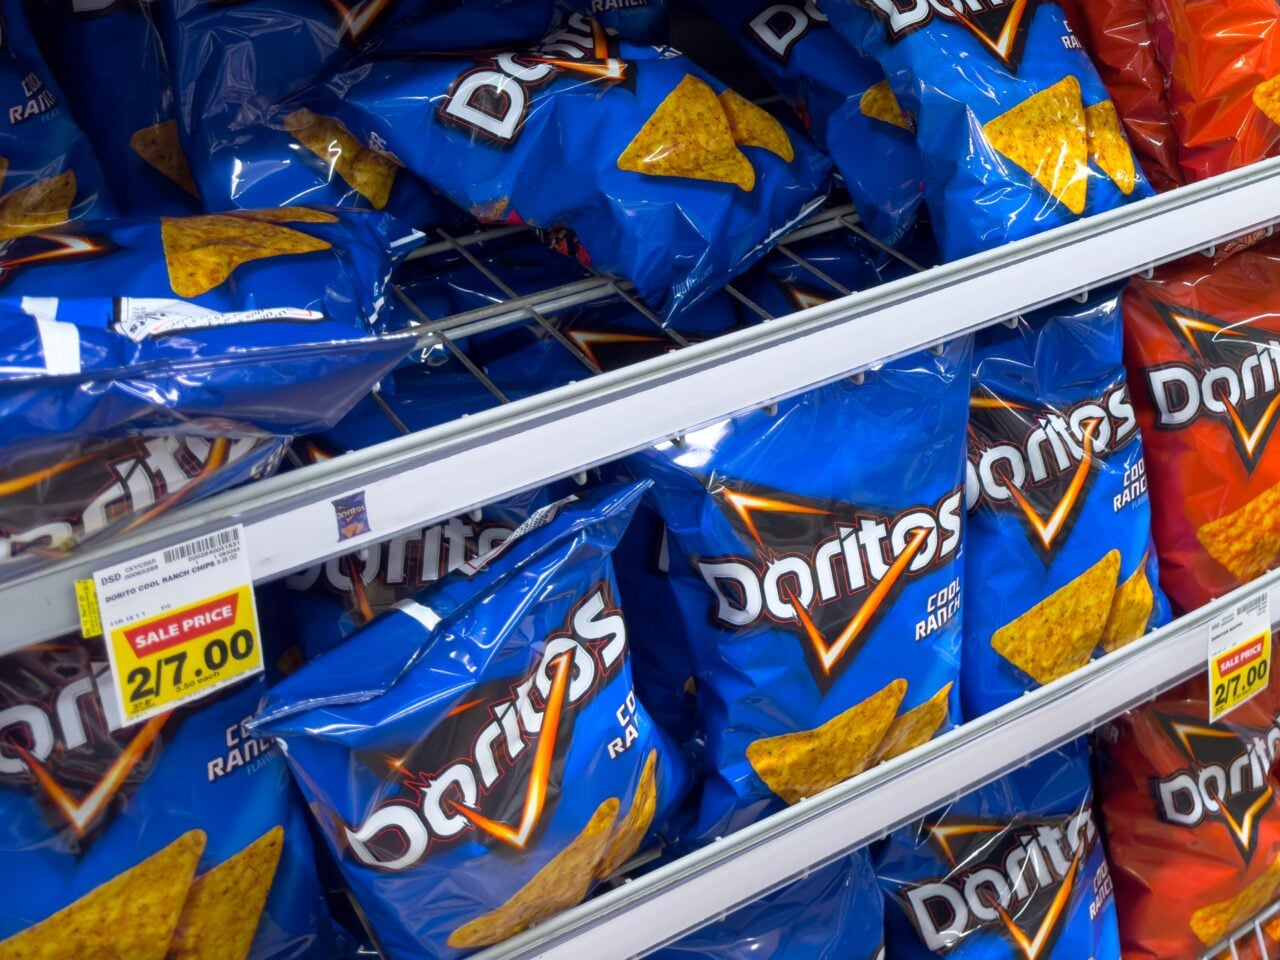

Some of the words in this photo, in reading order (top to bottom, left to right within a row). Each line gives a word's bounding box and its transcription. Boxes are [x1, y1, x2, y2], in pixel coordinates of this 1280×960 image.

[101, 573, 122, 586] DSD
[699, 490, 961, 626] Doritos
[105, 587, 137, 603] DORITO
[138, 580, 160, 592] COOL
[161, 570, 190, 585] RANCH
[191, 561, 215, 574] CHIPS
[926, 578, 961, 612] COOL
[134, 623, 180, 649] SALE
[182, 604, 233, 632] PRICE
[915, 598, 961, 642] RANCH
[126, 628, 254, 703] 2/7.00
[1219, 656, 1240, 672] SALE
[1240, 642, 1262, 660] PRICE
[1214, 659, 1268, 708] 2/7.00
[345, 593, 627, 870] Doritos
[907, 808, 1098, 951] Dorito
